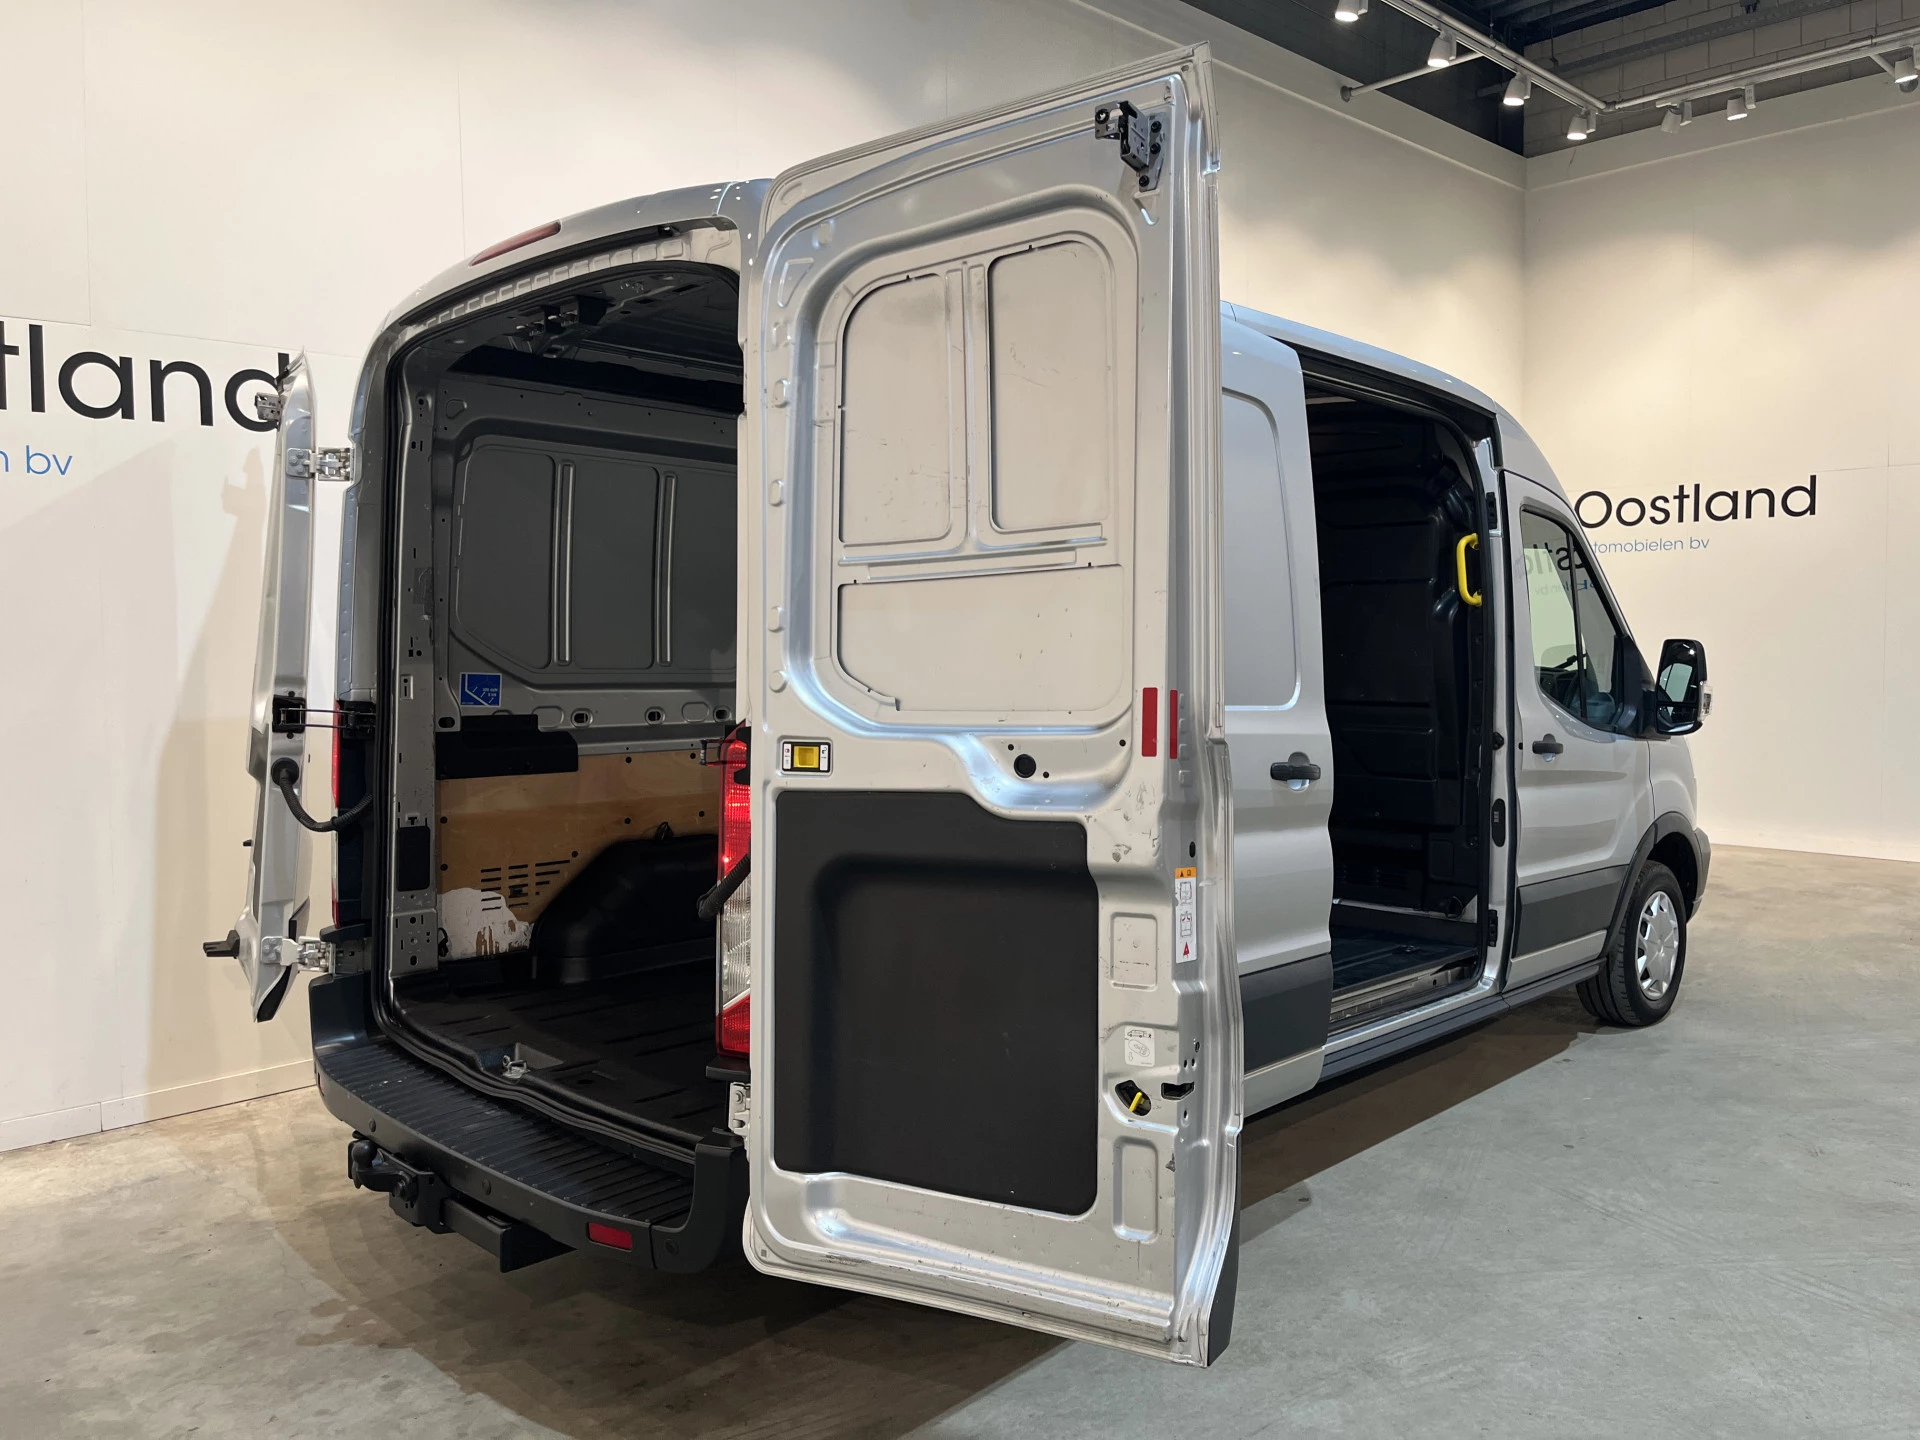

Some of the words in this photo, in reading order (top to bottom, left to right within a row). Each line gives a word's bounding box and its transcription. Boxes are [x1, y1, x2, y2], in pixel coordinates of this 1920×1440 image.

[25, 445, 73, 476] bv
[1573, 474, 1817, 529] Oostland
[1689, 536, 1710, 550] bv
